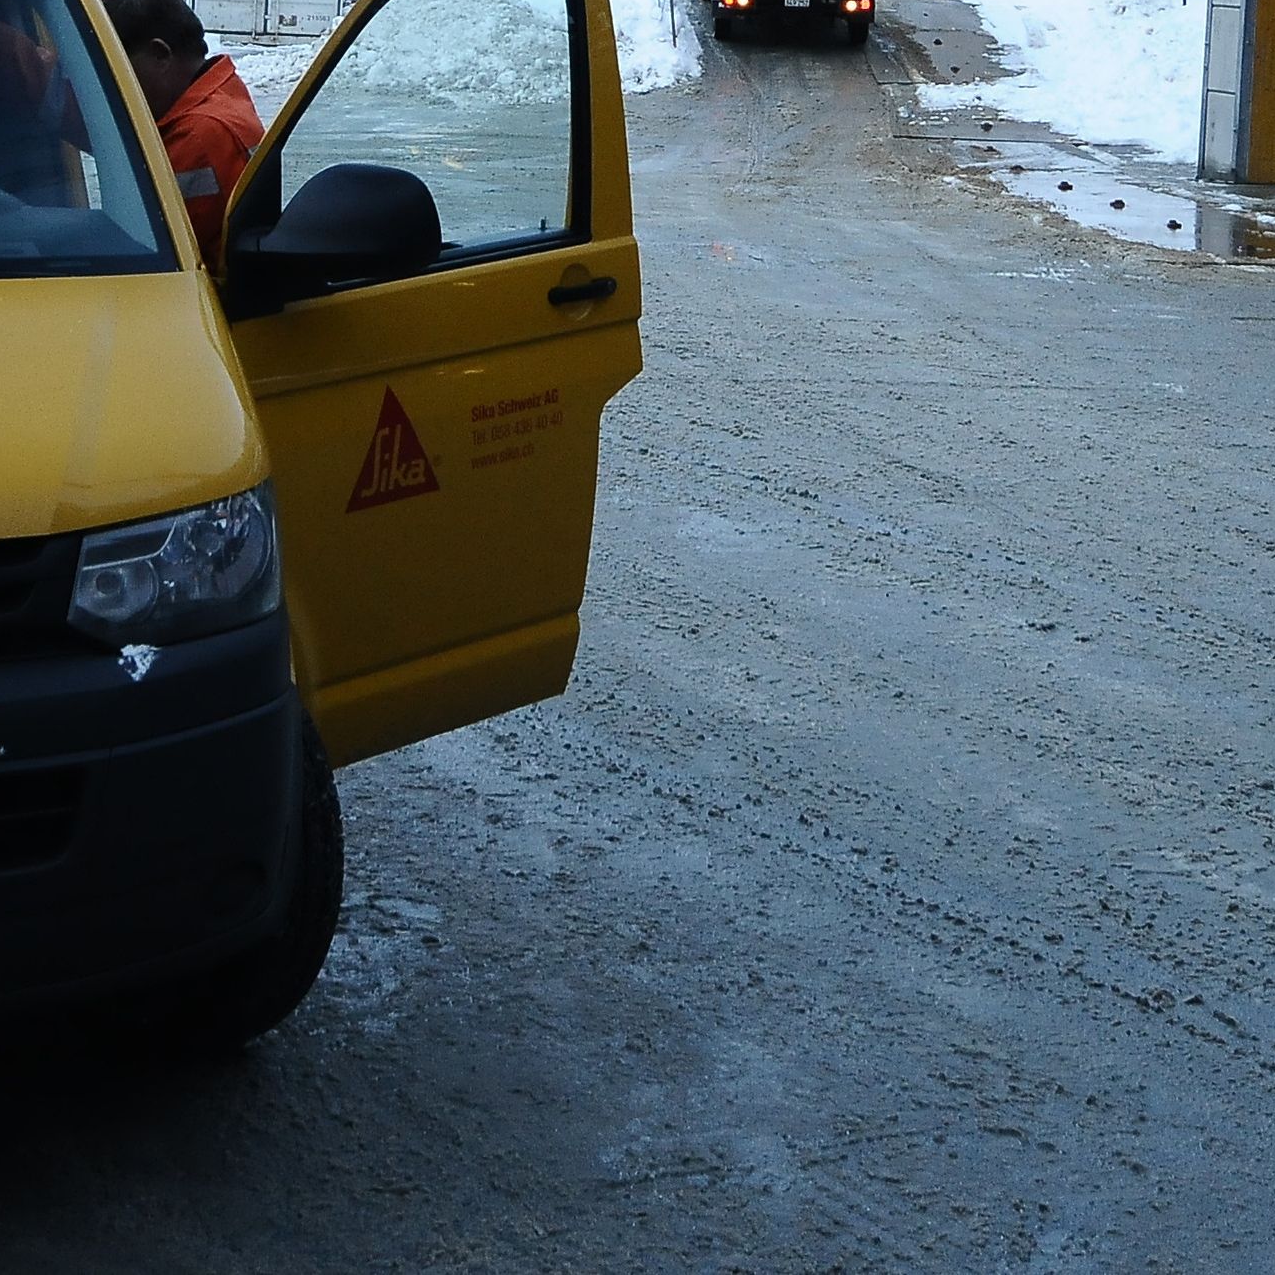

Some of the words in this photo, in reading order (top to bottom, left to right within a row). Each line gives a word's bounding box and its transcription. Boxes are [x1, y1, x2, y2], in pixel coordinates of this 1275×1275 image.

[471, 404, 495, 423] Sika
[498, 393, 541, 417] Schweiz
[544, 388, 559, 405] AG
[361, 423, 427, 498] Sika
